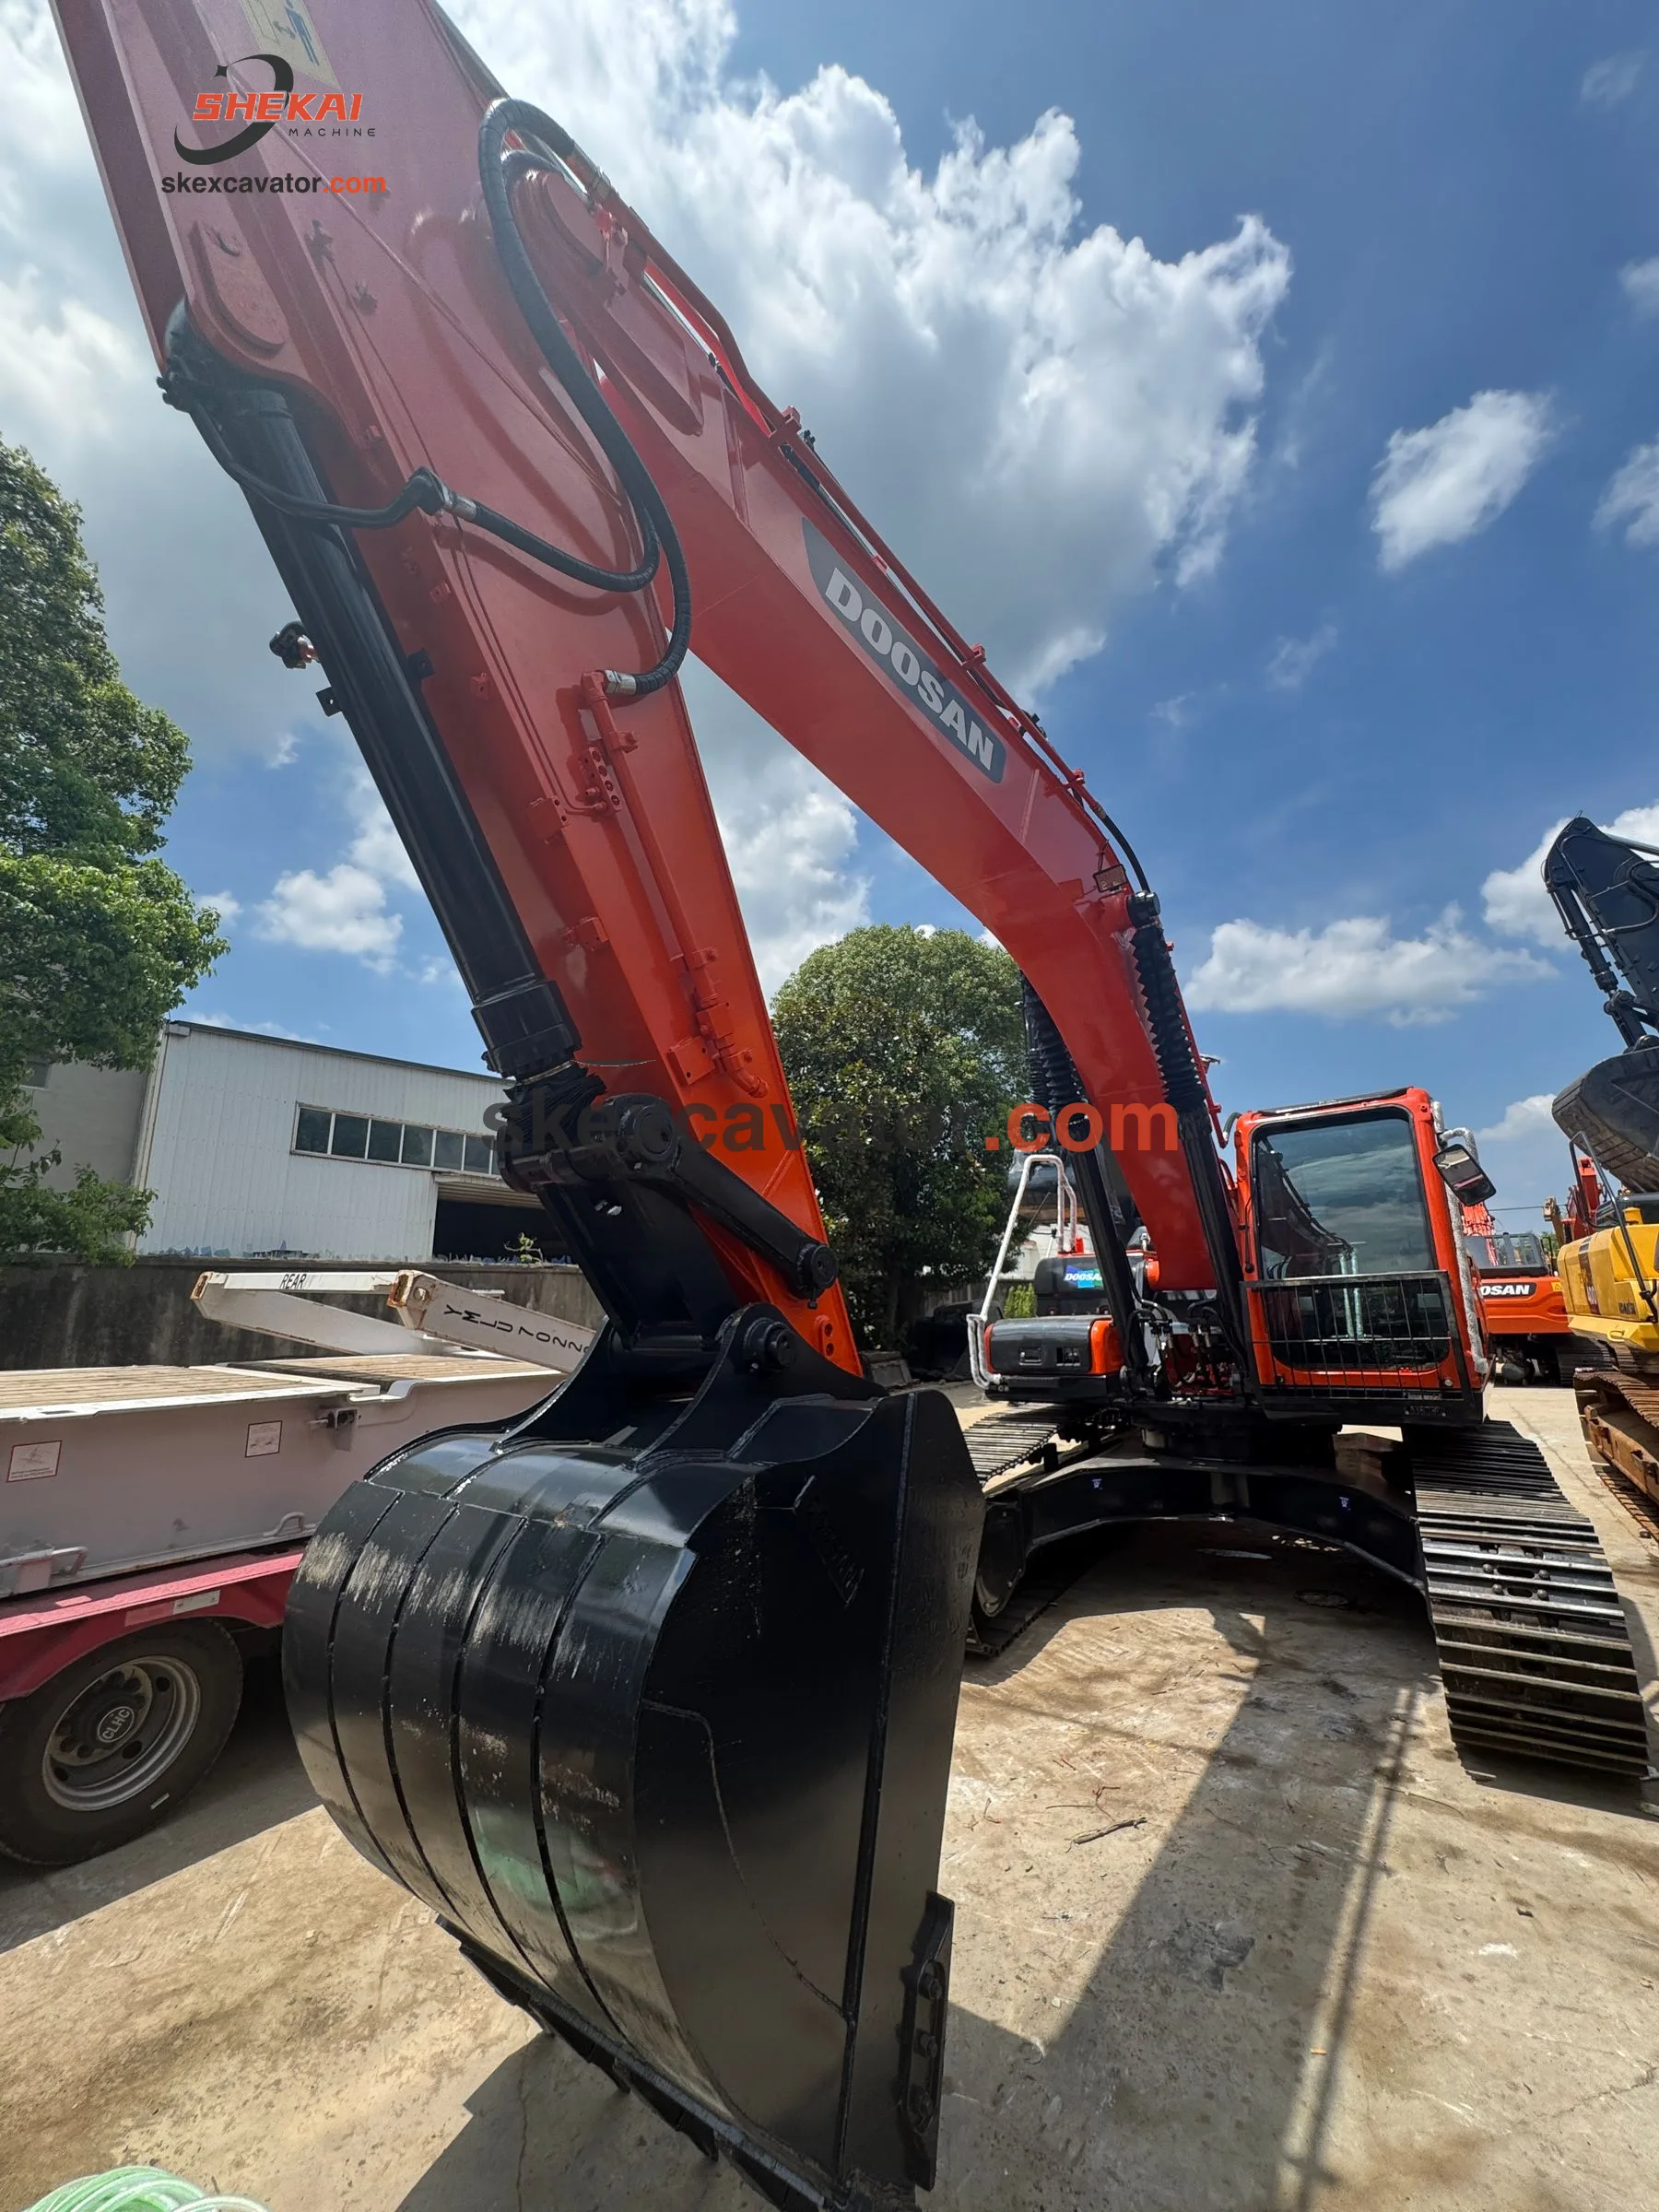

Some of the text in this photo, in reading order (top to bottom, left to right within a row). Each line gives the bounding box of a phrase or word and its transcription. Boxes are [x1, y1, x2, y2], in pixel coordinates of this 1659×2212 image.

[825, 566, 994, 771] DOOSAN
[278, 1273, 308, 1289] REAR
[1064, 1273, 1102, 1281] DOOSA
[443, 1303, 513, 1334] YMLU
